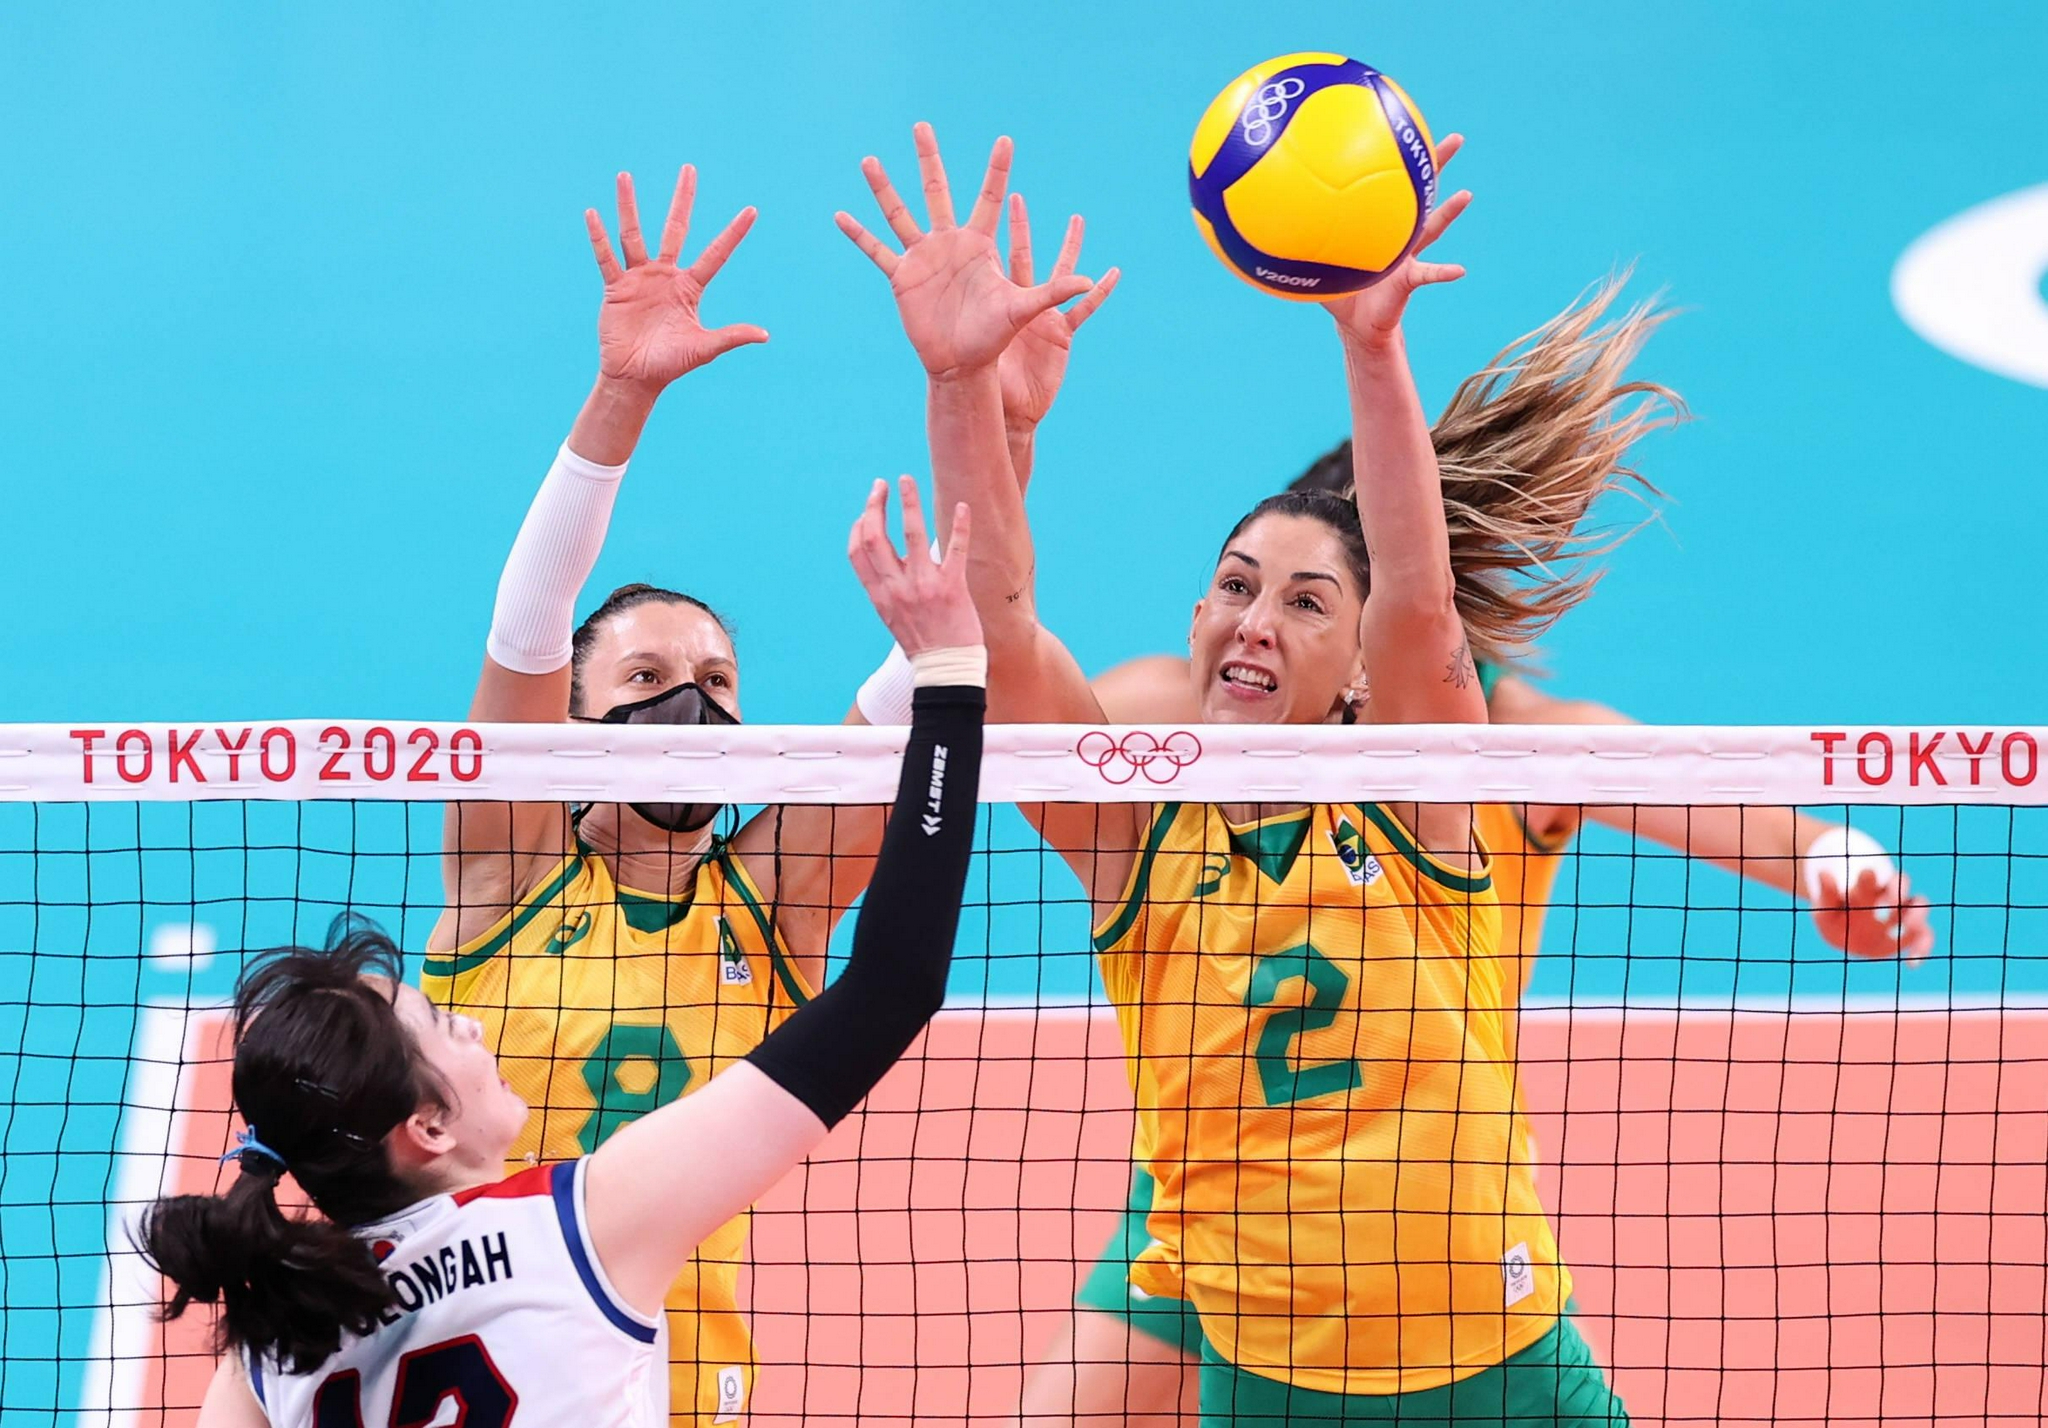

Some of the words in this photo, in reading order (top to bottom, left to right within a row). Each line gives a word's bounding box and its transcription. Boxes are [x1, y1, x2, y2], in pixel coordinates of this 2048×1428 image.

[1395, 116, 1432, 181] TOKYO
[1255, 266, 1321, 288] V200W
[69, 727, 297, 784] TOKYO
[318, 727, 483, 783] 2020
[1810, 731, 2038, 787] TOKYO
[1242, 941, 1365, 1106] 2
[575, 1022, 695, 1155] 8
